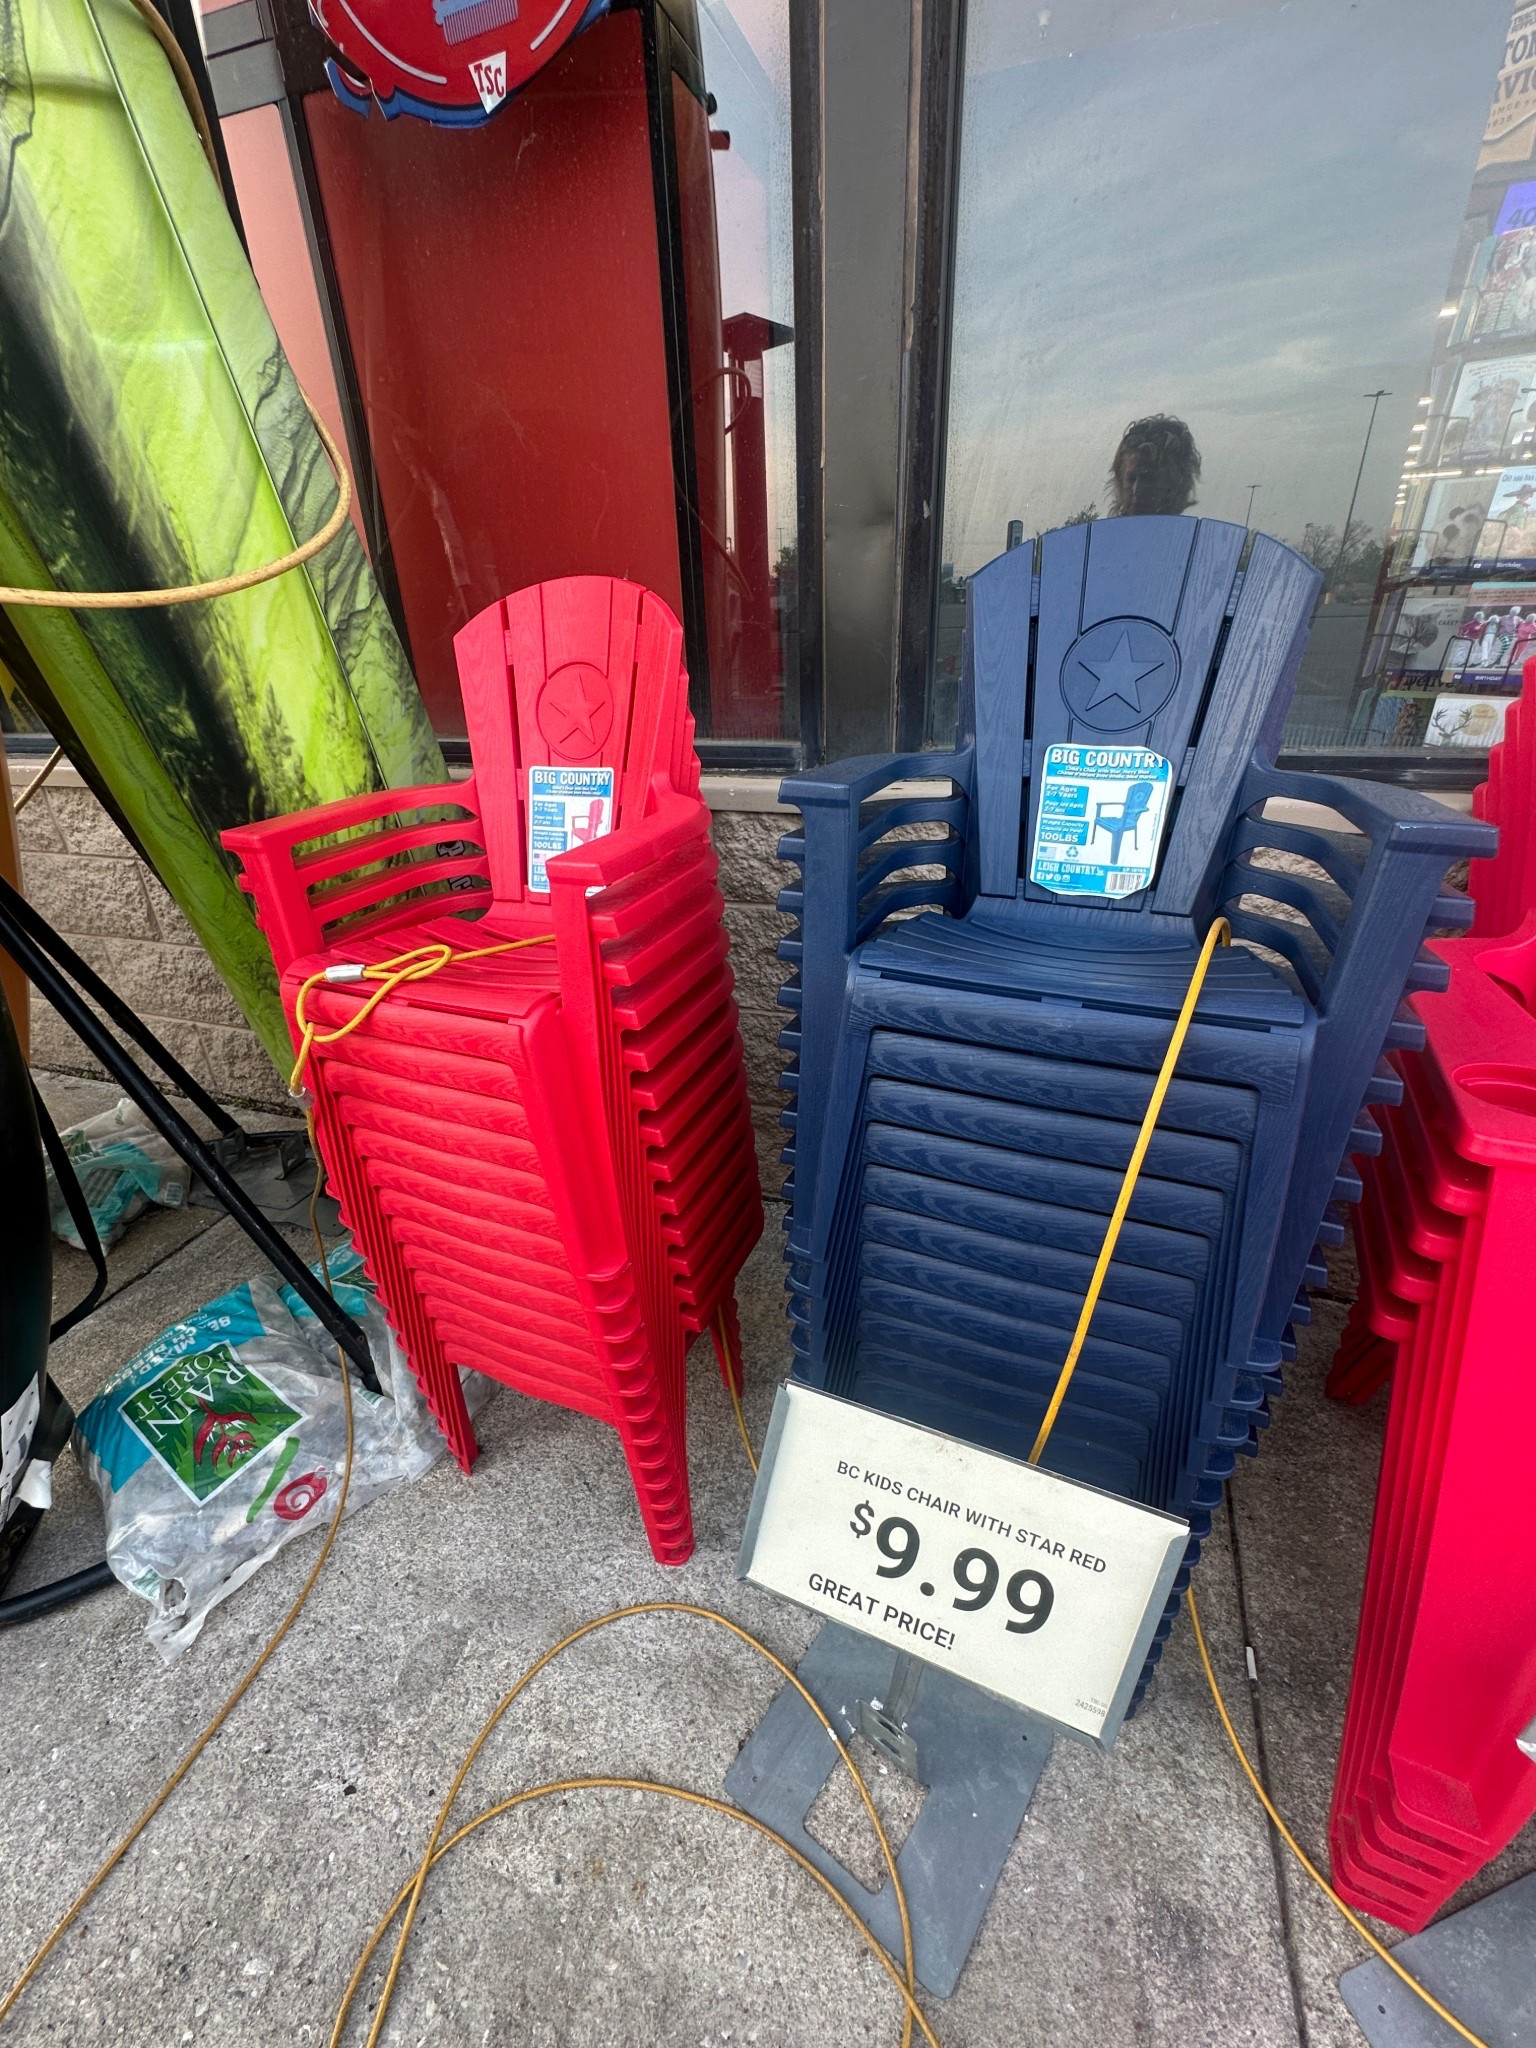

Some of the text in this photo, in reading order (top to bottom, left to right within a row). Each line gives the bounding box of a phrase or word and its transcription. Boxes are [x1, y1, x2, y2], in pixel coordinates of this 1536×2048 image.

[474, 63, 505, 98] TSC
[1051, 748, 1163, 768] BIG COUNTRY
[535, 771, 610, 786] BIG COUNTRY
[534, 841, 562, 849] 100LBS
[1041, 831, 1079, 842] 100LBS
[1038, 861, 1096, 875] LEIGH COUNTRY
[135, 1351, 226, 1419] FOREST
[146, 1367, 249, 1442] RAIN
[837, 1460, 1107, 1573] BC KIDS CHAIR WITH STAR RED
[849, 1500, 1055, 1635] $9.99
[808, 1573, 956, 1650] GREAT PRICE!
